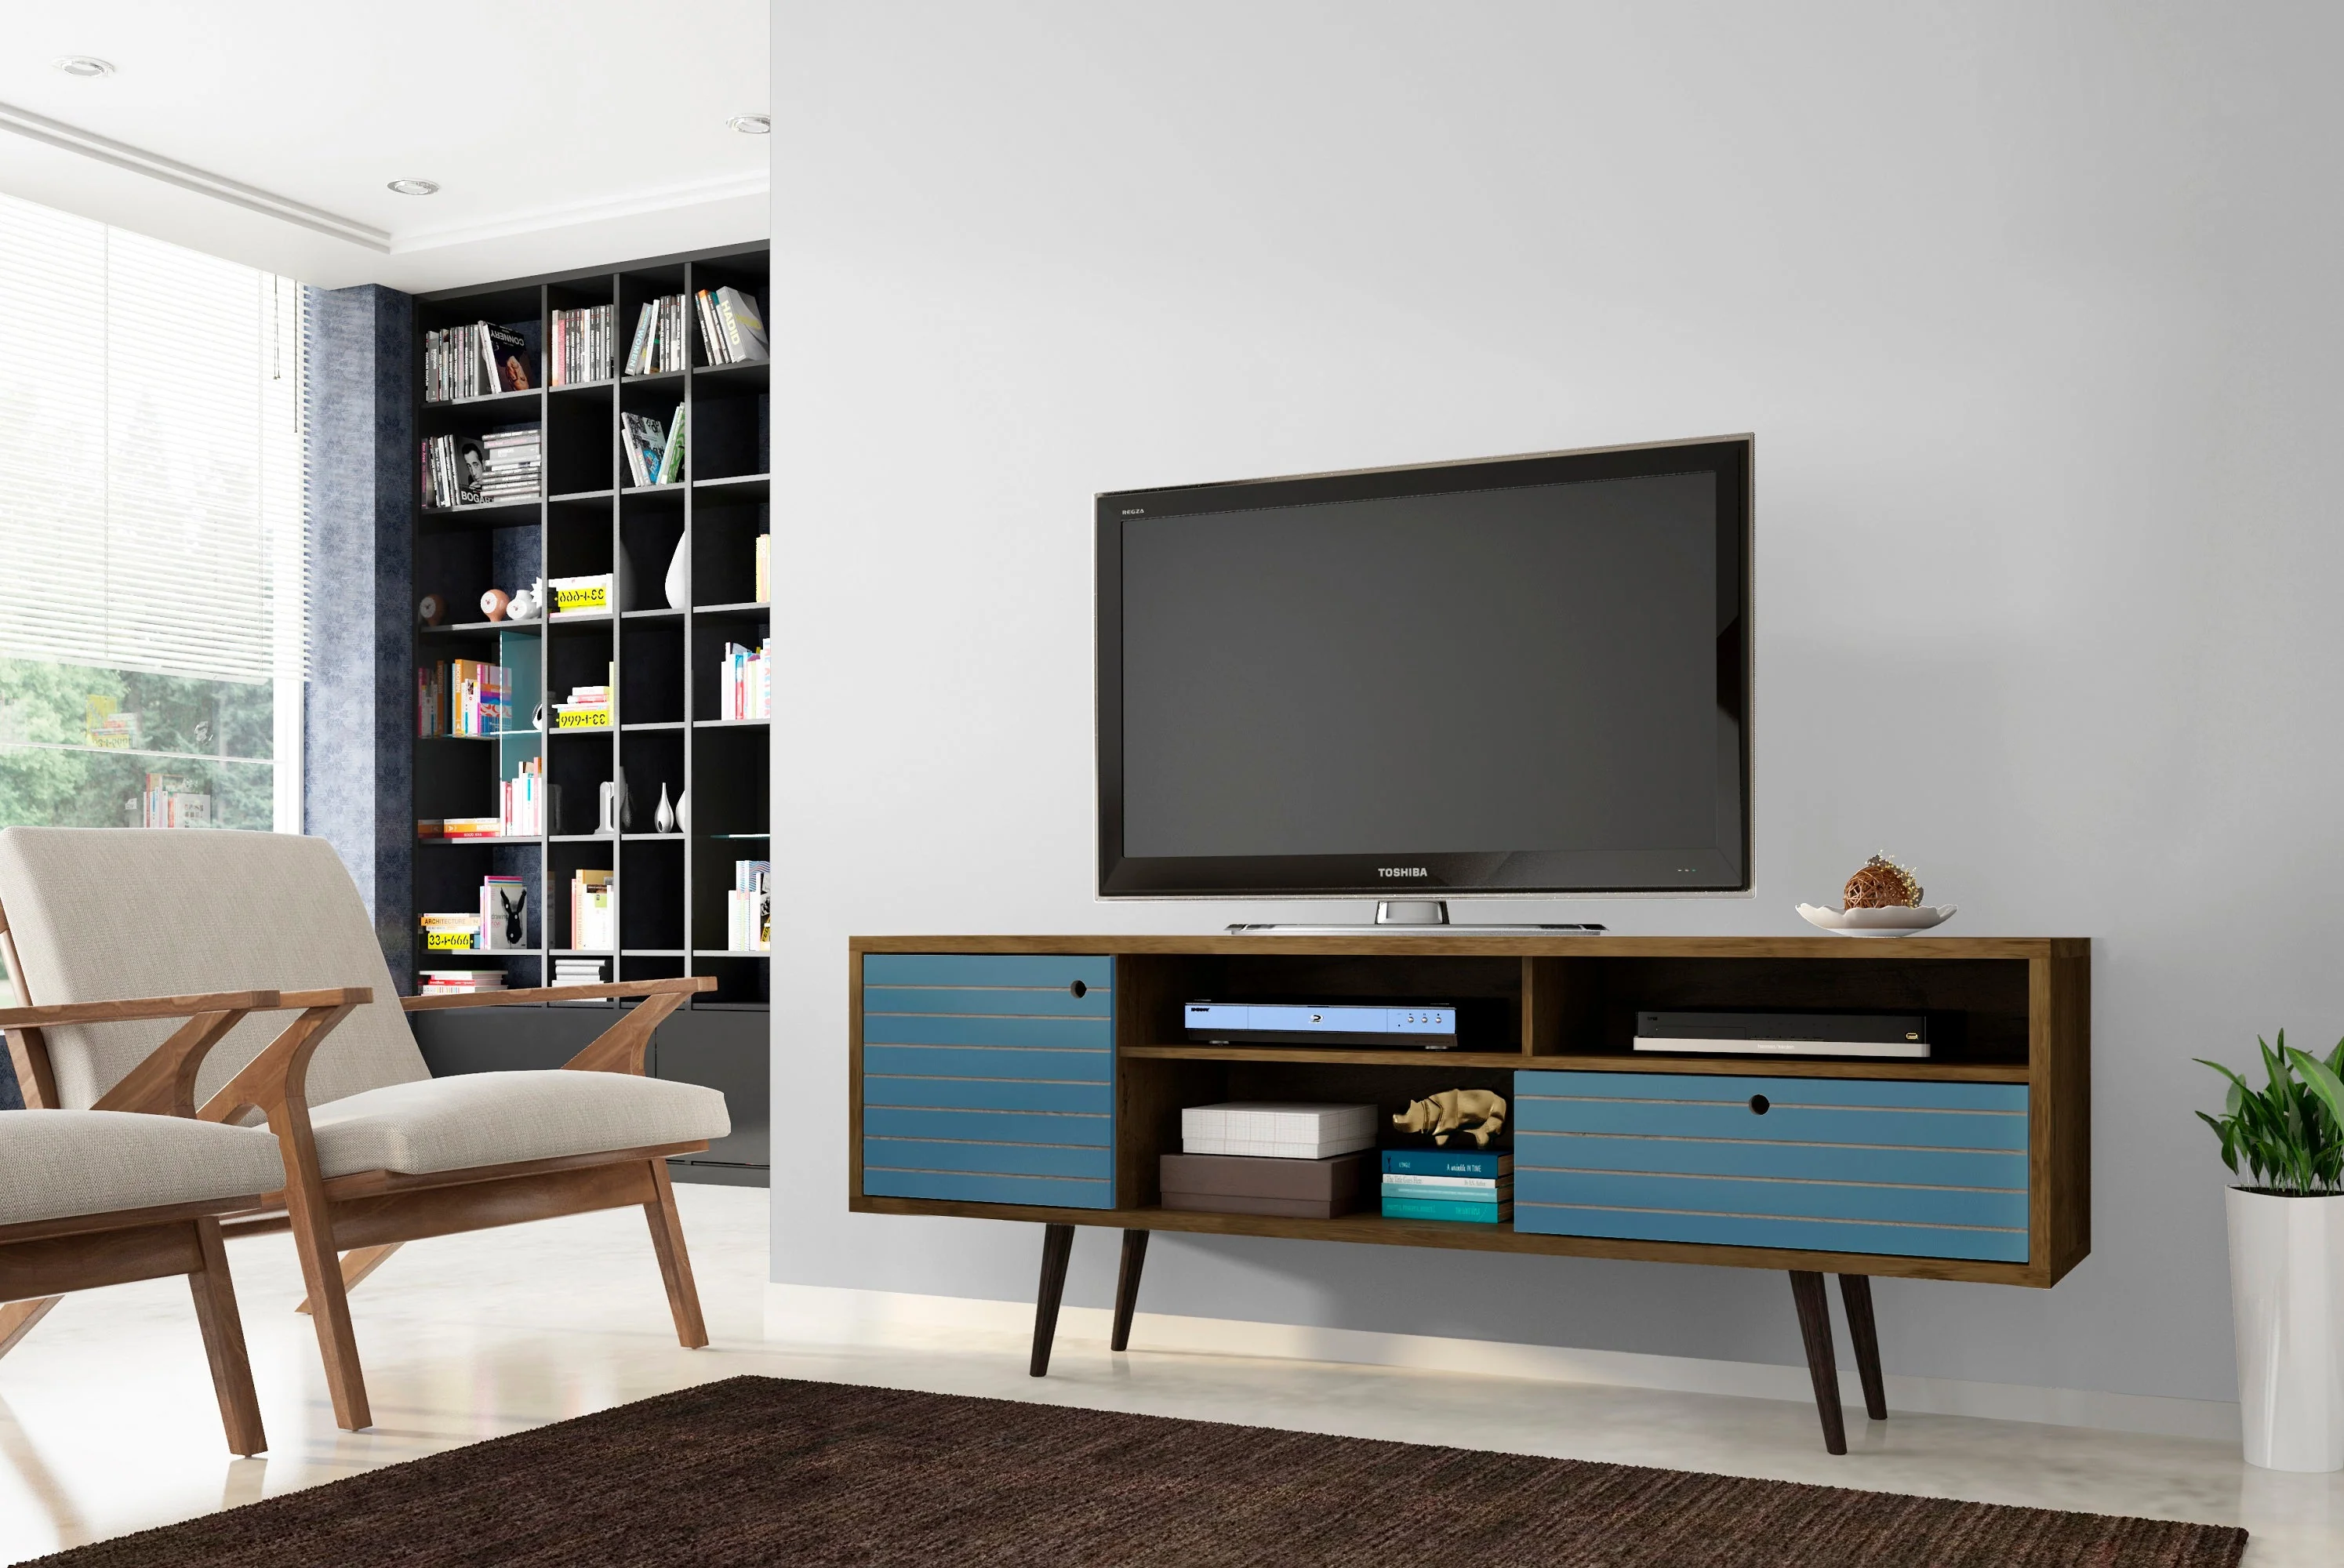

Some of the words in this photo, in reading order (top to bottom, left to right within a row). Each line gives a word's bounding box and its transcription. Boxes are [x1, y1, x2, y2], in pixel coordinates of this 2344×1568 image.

[721, 300, 740, 345] HADID
[491, 329, 525, 347] CONNERY
[629, 330, 644, 367] WOMEN
[1378, 867, 1427, 877] TOSHIBA
